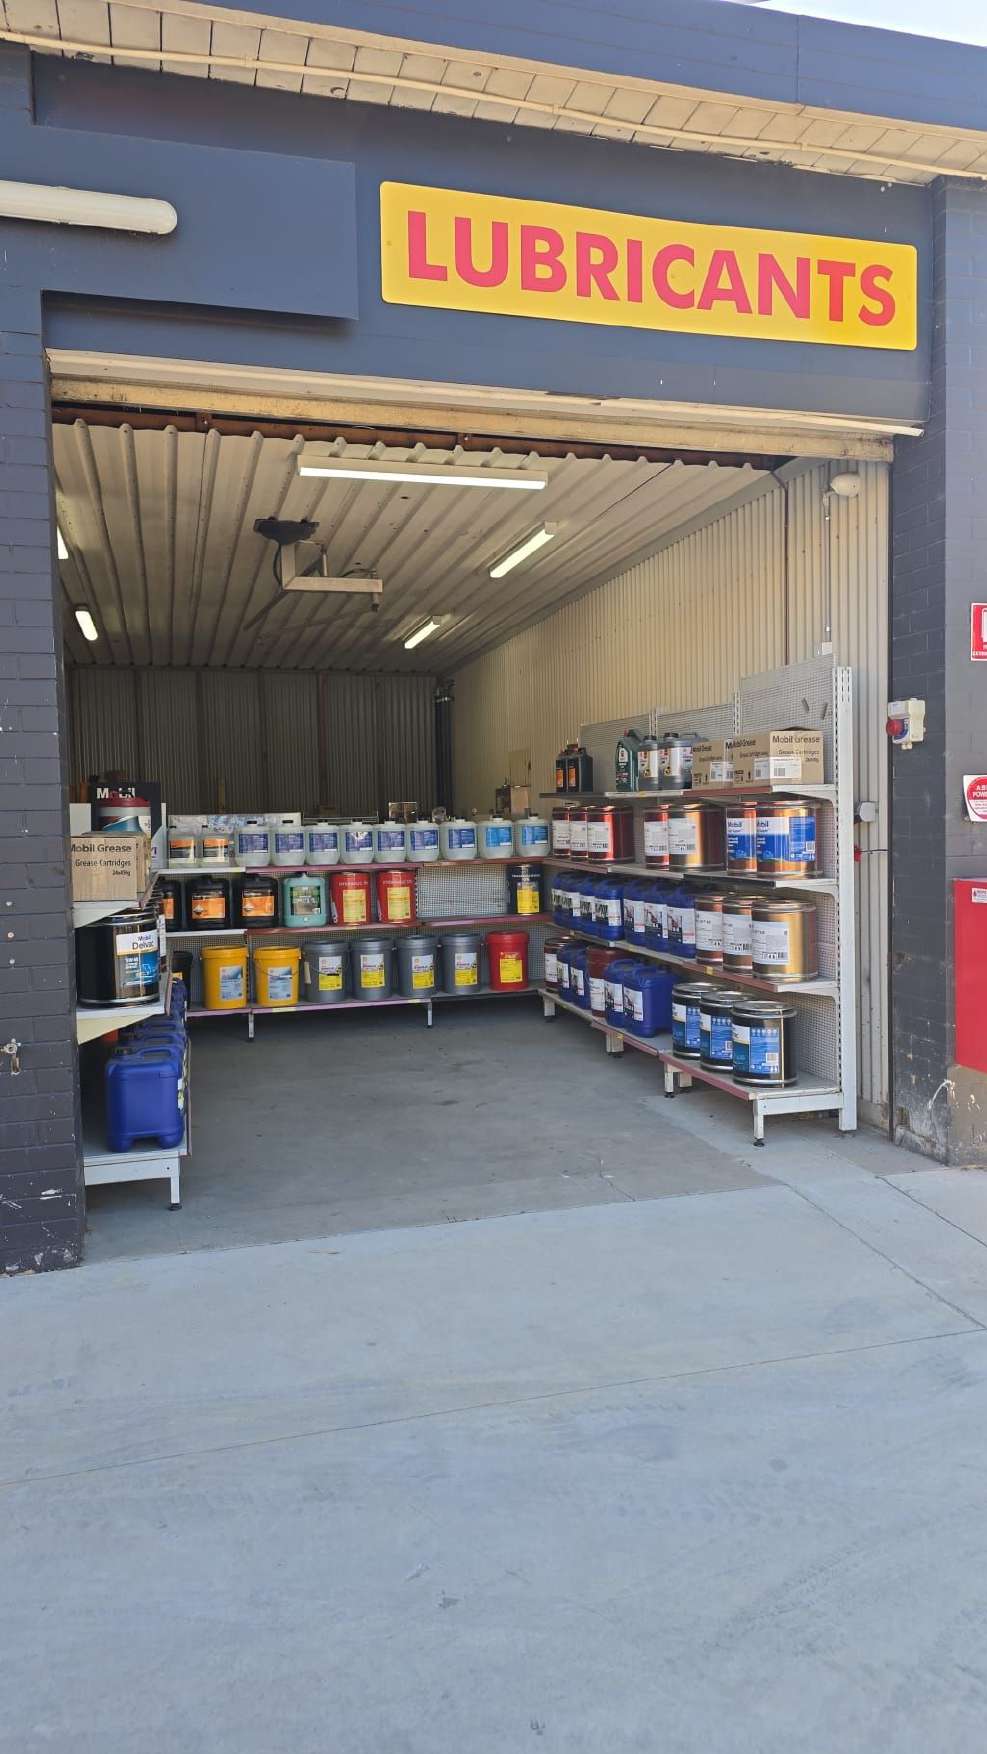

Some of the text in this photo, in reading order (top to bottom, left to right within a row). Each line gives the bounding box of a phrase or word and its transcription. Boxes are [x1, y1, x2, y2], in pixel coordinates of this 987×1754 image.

[407, 209, 896, 327] LUBRICANTS
[772, 734, 820, 744] Mobil Grease
[97, 843, 132, 853] Grease
